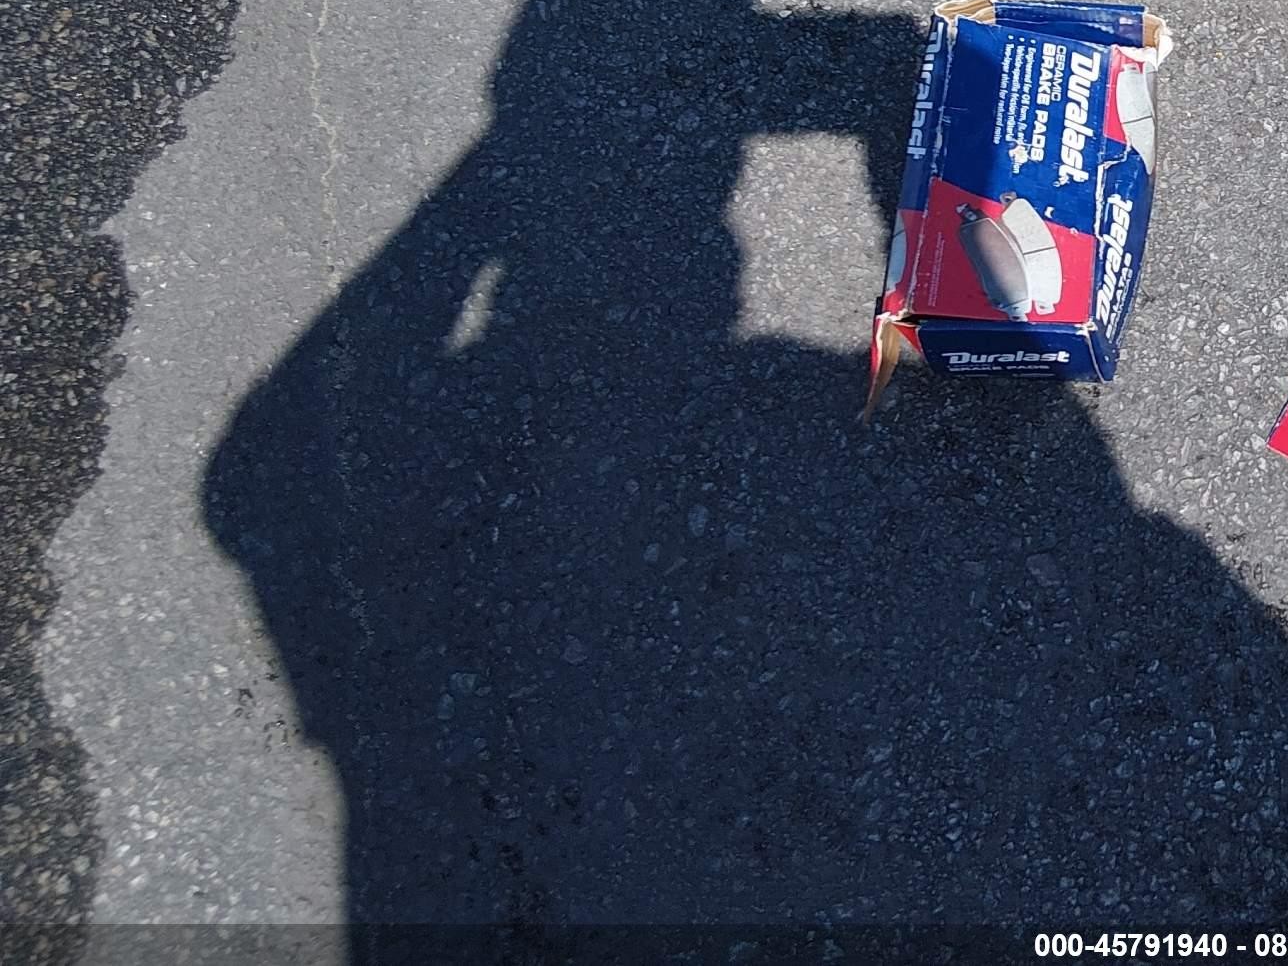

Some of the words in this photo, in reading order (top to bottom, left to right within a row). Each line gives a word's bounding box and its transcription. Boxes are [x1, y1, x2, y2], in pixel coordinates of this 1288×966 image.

[1037, 43, 1057, 106] BRAKE
[1050, 44, 1067, 102] CERAMIC
[1030, 109, 1048, 162] PADS
[1059, 52, 1100, 184] Duralast
[1095, 192, 1134, 324] Duralast
[940, 350, 1070, 364] Duralast
